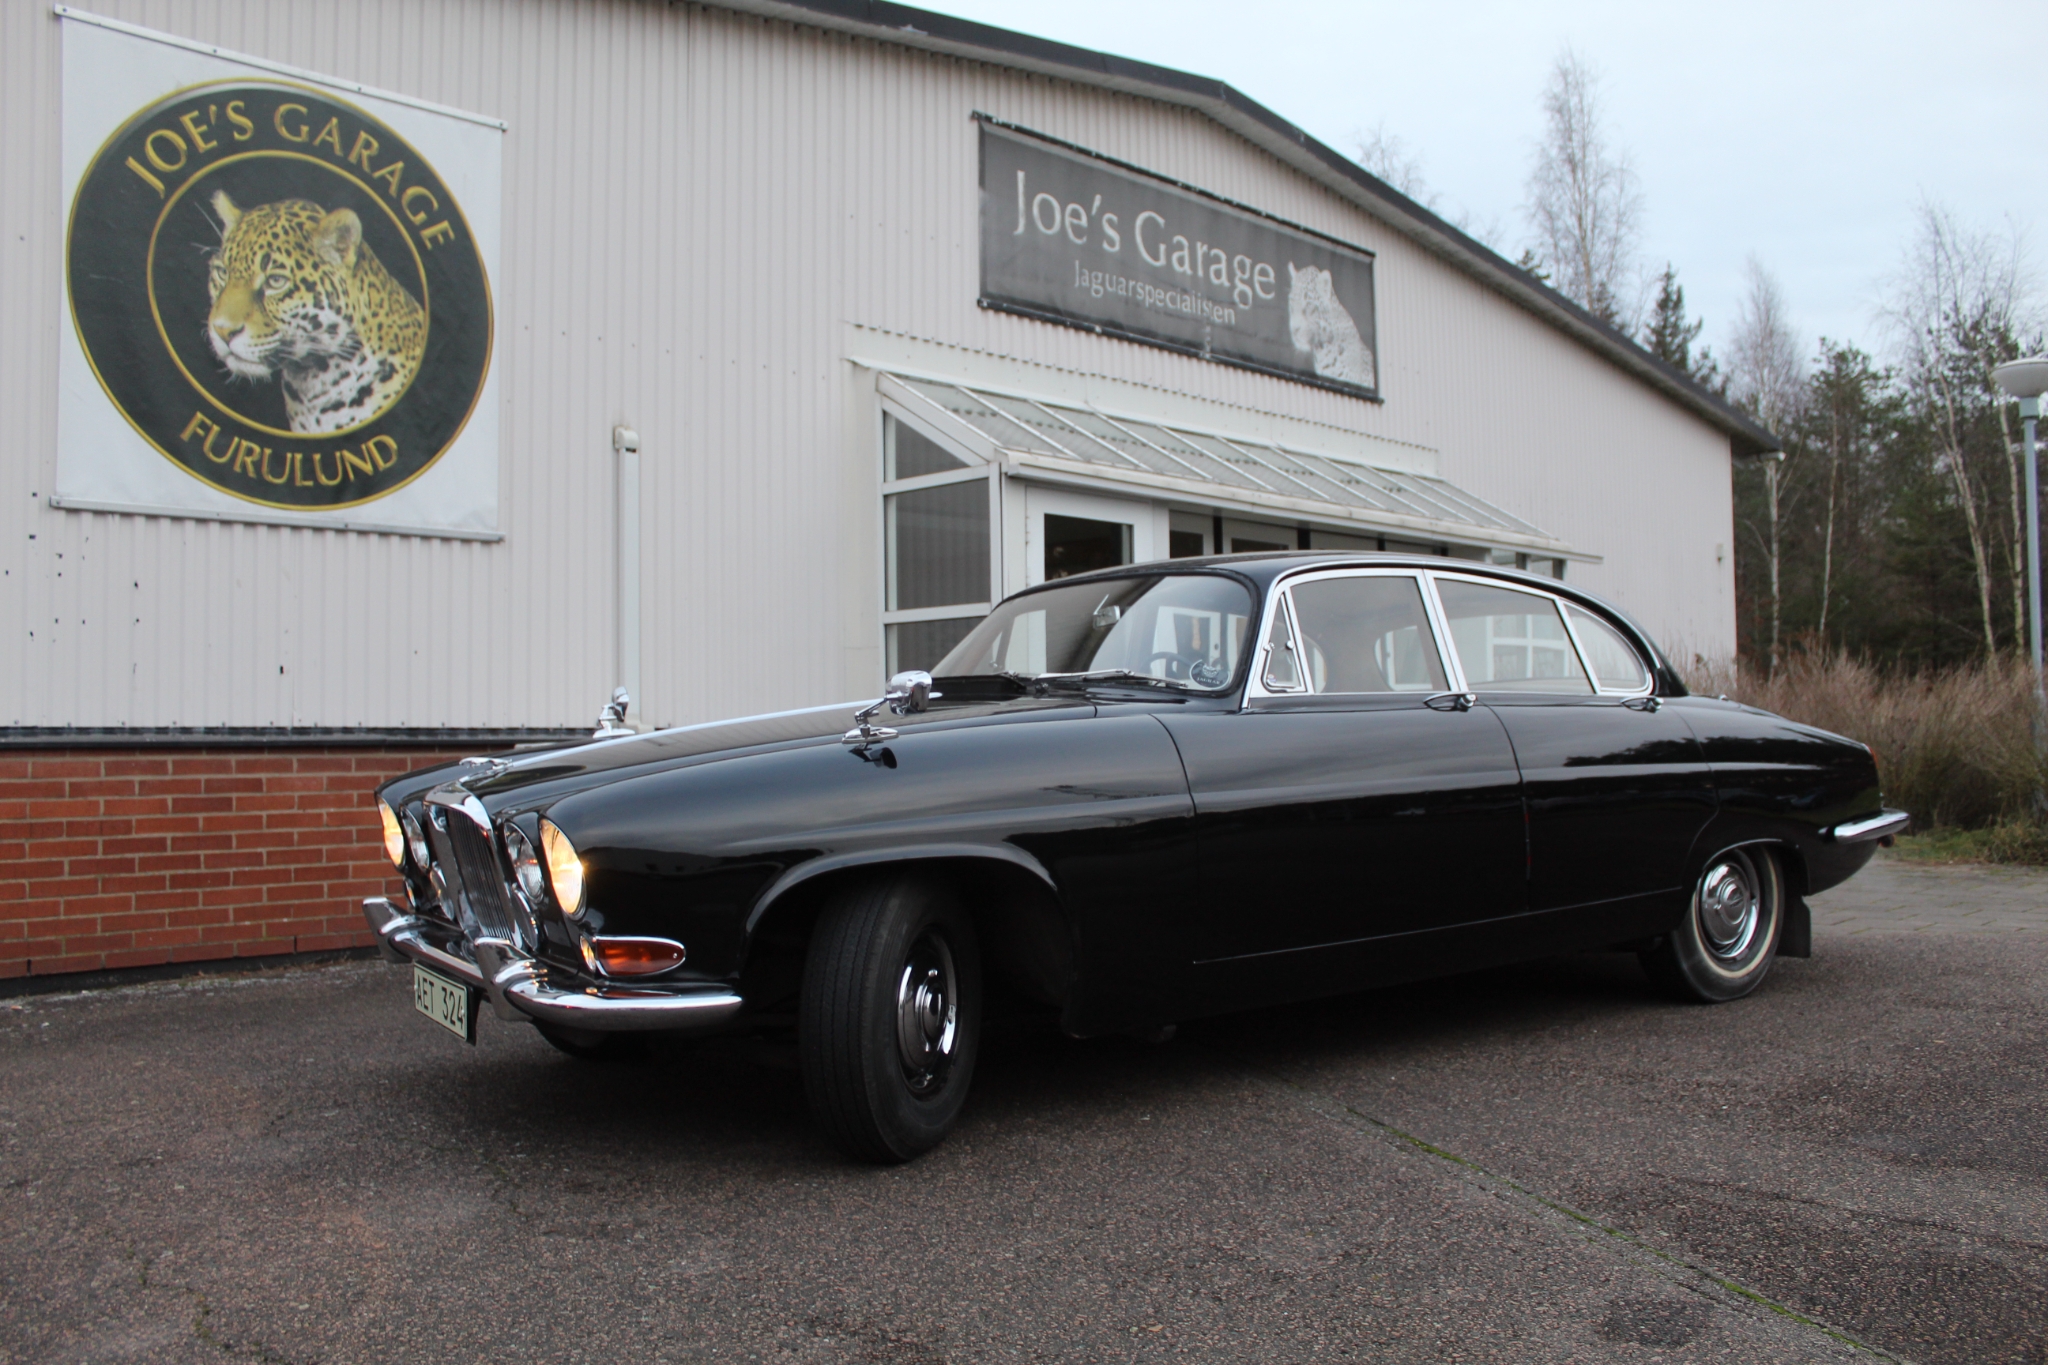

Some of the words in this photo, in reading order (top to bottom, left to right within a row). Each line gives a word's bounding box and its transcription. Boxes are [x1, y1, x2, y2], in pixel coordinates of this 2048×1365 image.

[126, 100, 254, 198] JOE'S
[273, 102, 455, 250] GARAGE
[1015, 170, 1121, 252] Joe's
[1135, 211, 1275, 309] Garage
[1073, 259, 1235, 325] Jaguarspecialisten
[180, 411, 398, 486] FURULUND
[416, 974, 435, 1014] AET
[441, 987, 465, 1030] 324
